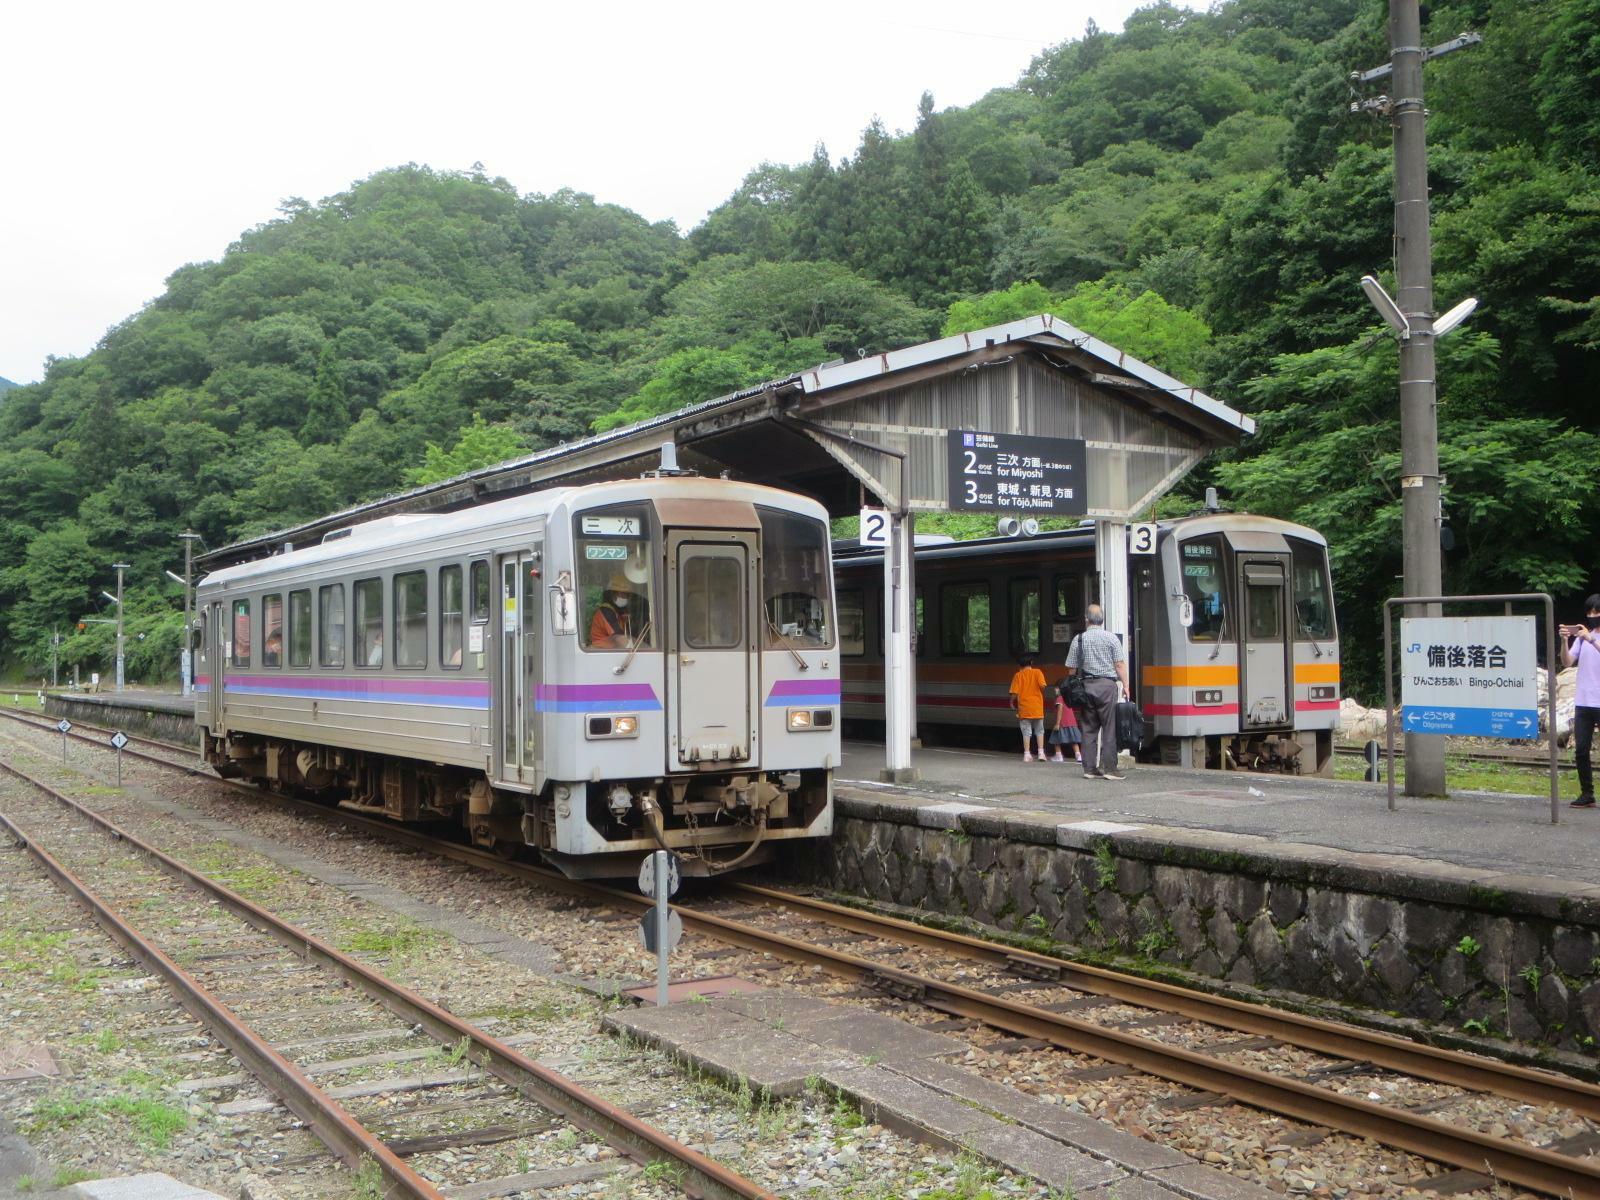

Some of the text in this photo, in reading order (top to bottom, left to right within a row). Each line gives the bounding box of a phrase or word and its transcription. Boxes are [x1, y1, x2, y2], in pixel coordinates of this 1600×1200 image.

[964, 451, 977, 474] 2
[997, 453, 1019, 466] 三次
[1022, 457, 1041, 468] 方面
[997, 466, 1043, 479] for Miyoshi
[965, 481, 978, 504] 3
[1055, 488, 1073, 499] 方面
[998, 496, 1010, 506] for
[585, 518, 634, 535] 三次
[867, 515, 885, 541] 2
[1136, 527, 1151, 552] 3
[588, 547, 625, 558] ワンマン
[1407, 643, 1421, 653] JR
[1427, 645, 1507, 668] 備後落合
[1413, 676, 1463, 687] びんごおちあい
[1469, 677, 1524, 689] Bingo-Ochiai
